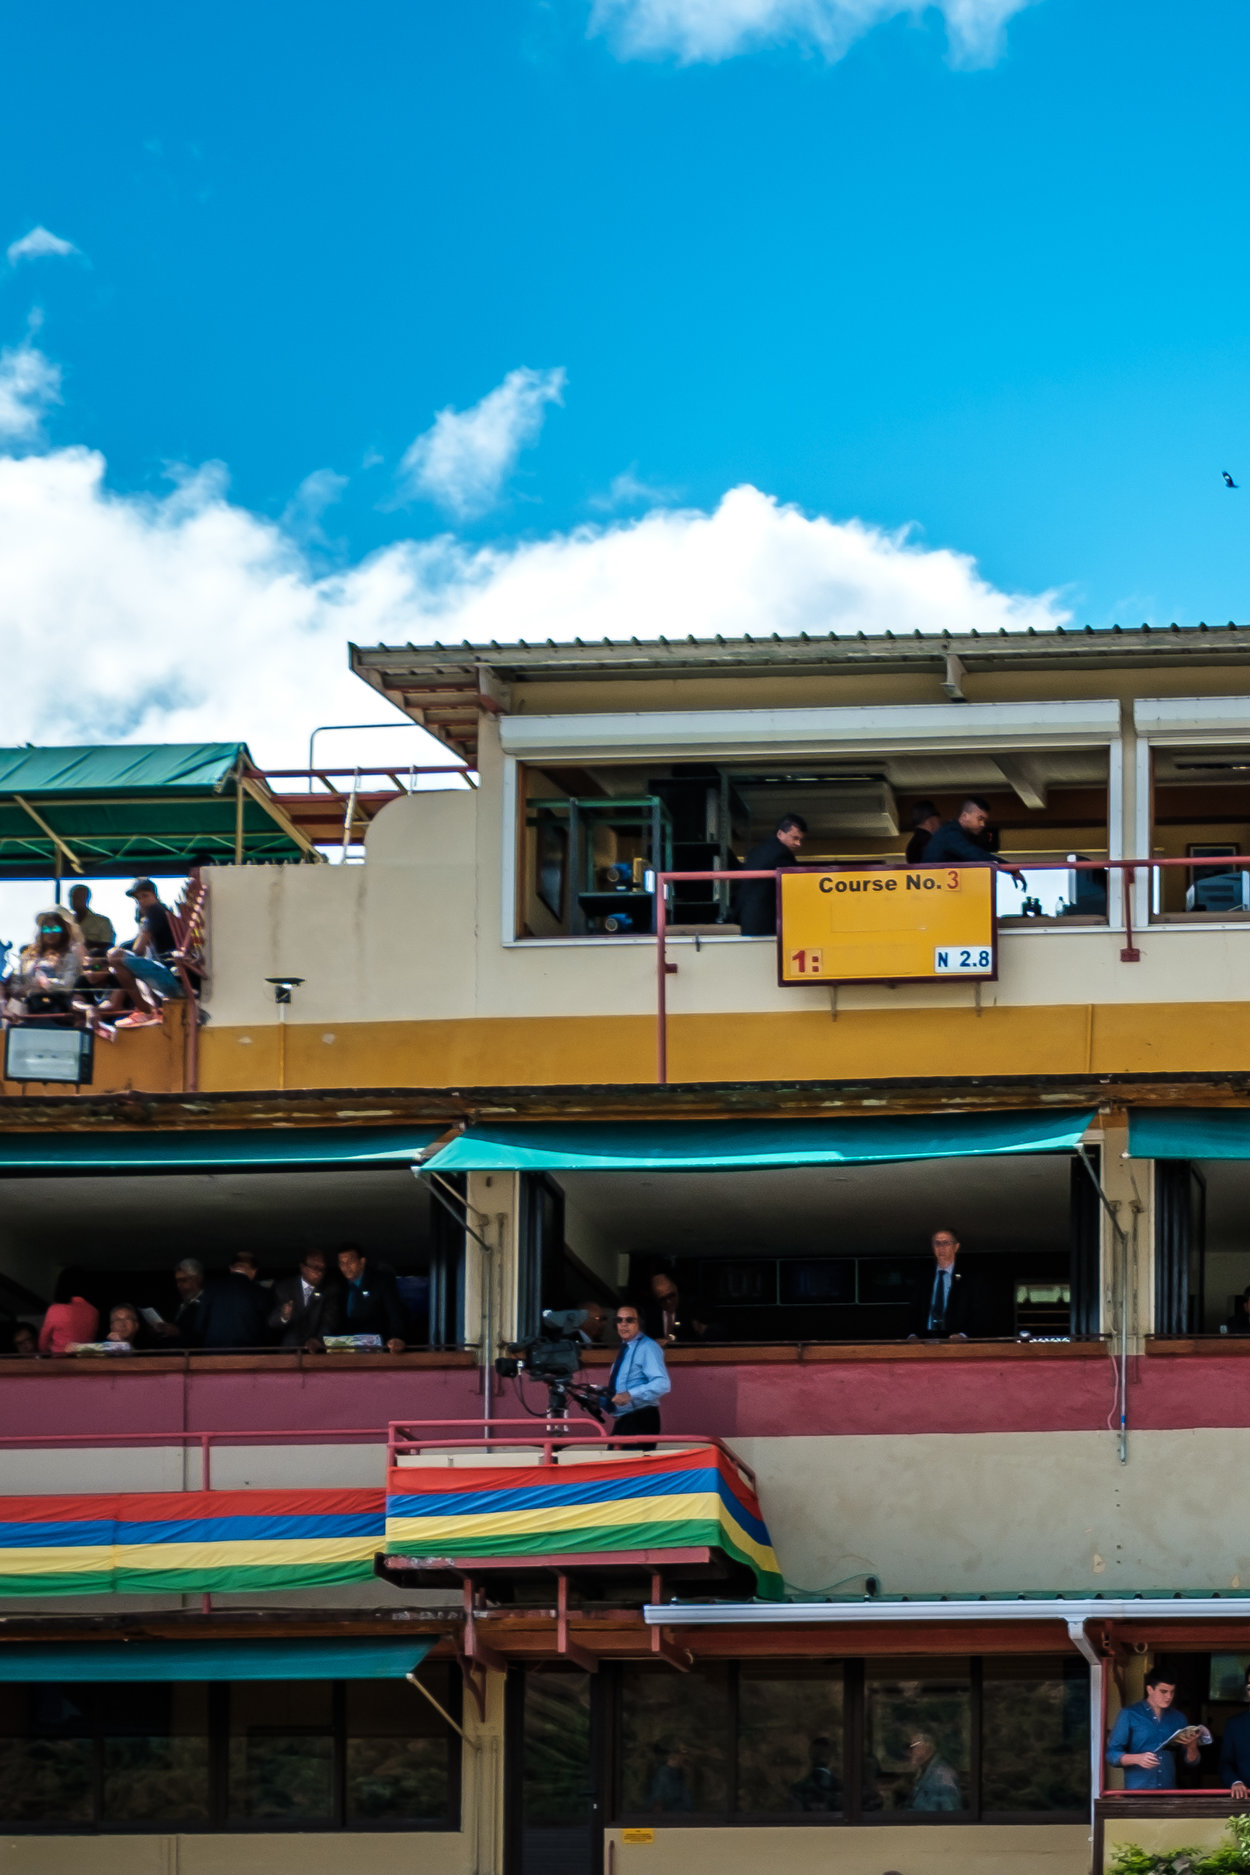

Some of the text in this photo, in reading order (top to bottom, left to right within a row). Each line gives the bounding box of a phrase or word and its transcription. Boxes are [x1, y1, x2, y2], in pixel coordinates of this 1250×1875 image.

[819, 870, 959, 893] Course No. 3
[937, 950, 990, 968] N 2.8
